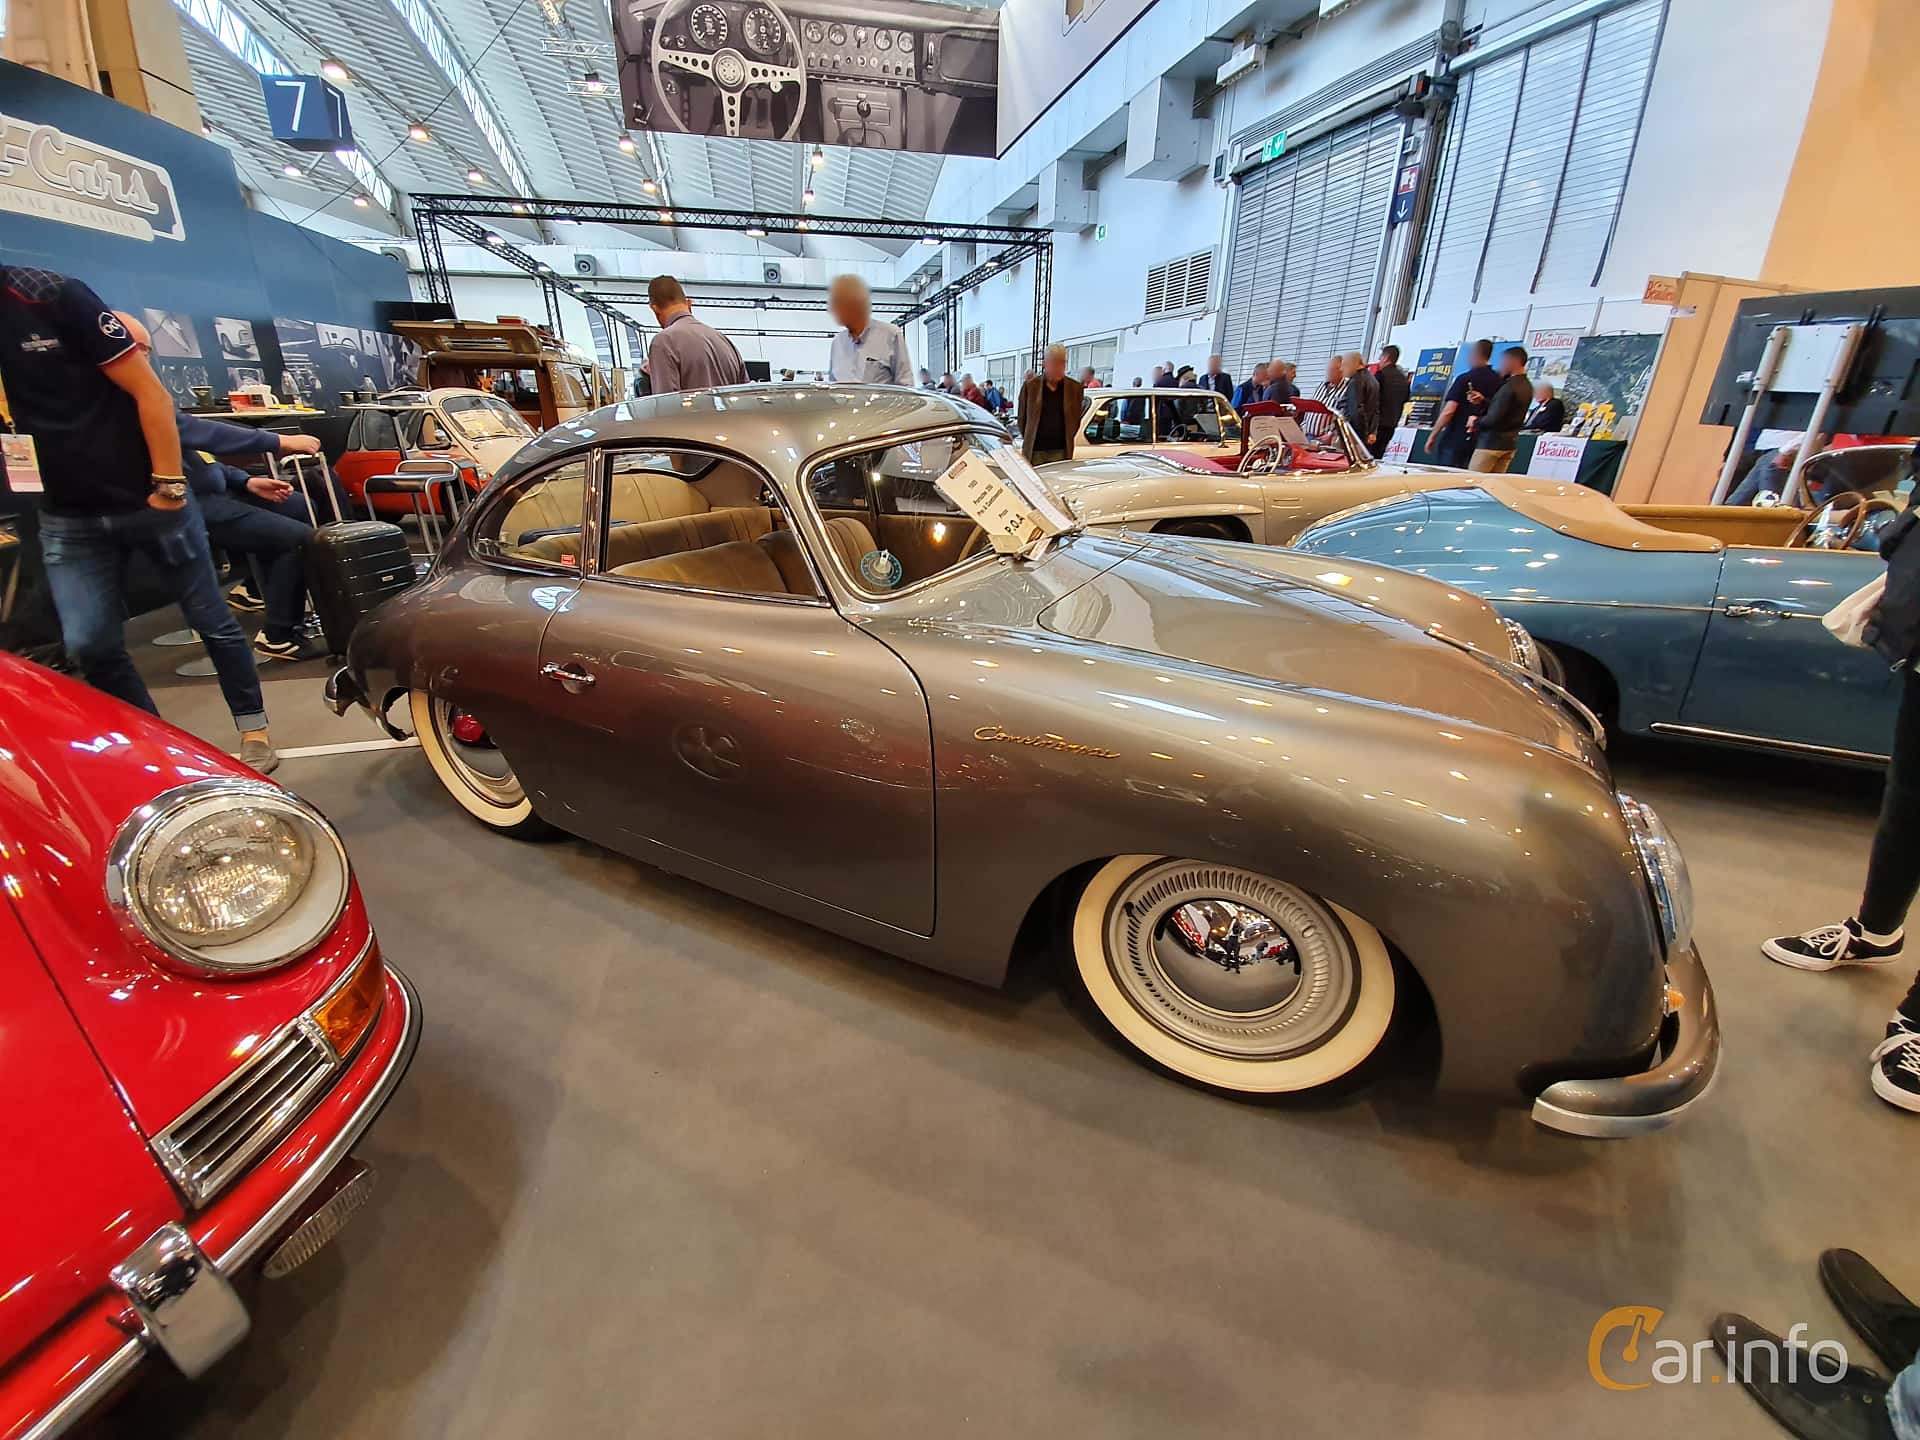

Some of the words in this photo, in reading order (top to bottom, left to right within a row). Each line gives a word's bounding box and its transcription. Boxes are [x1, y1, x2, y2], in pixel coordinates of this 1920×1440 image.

[275, 80, 306, 132] 7
[0, 119, 159, 214] -Cars
[1533, 332, 1574, 348] Beaulieu
[1536, 440, 1580, 458] Beaulieu
